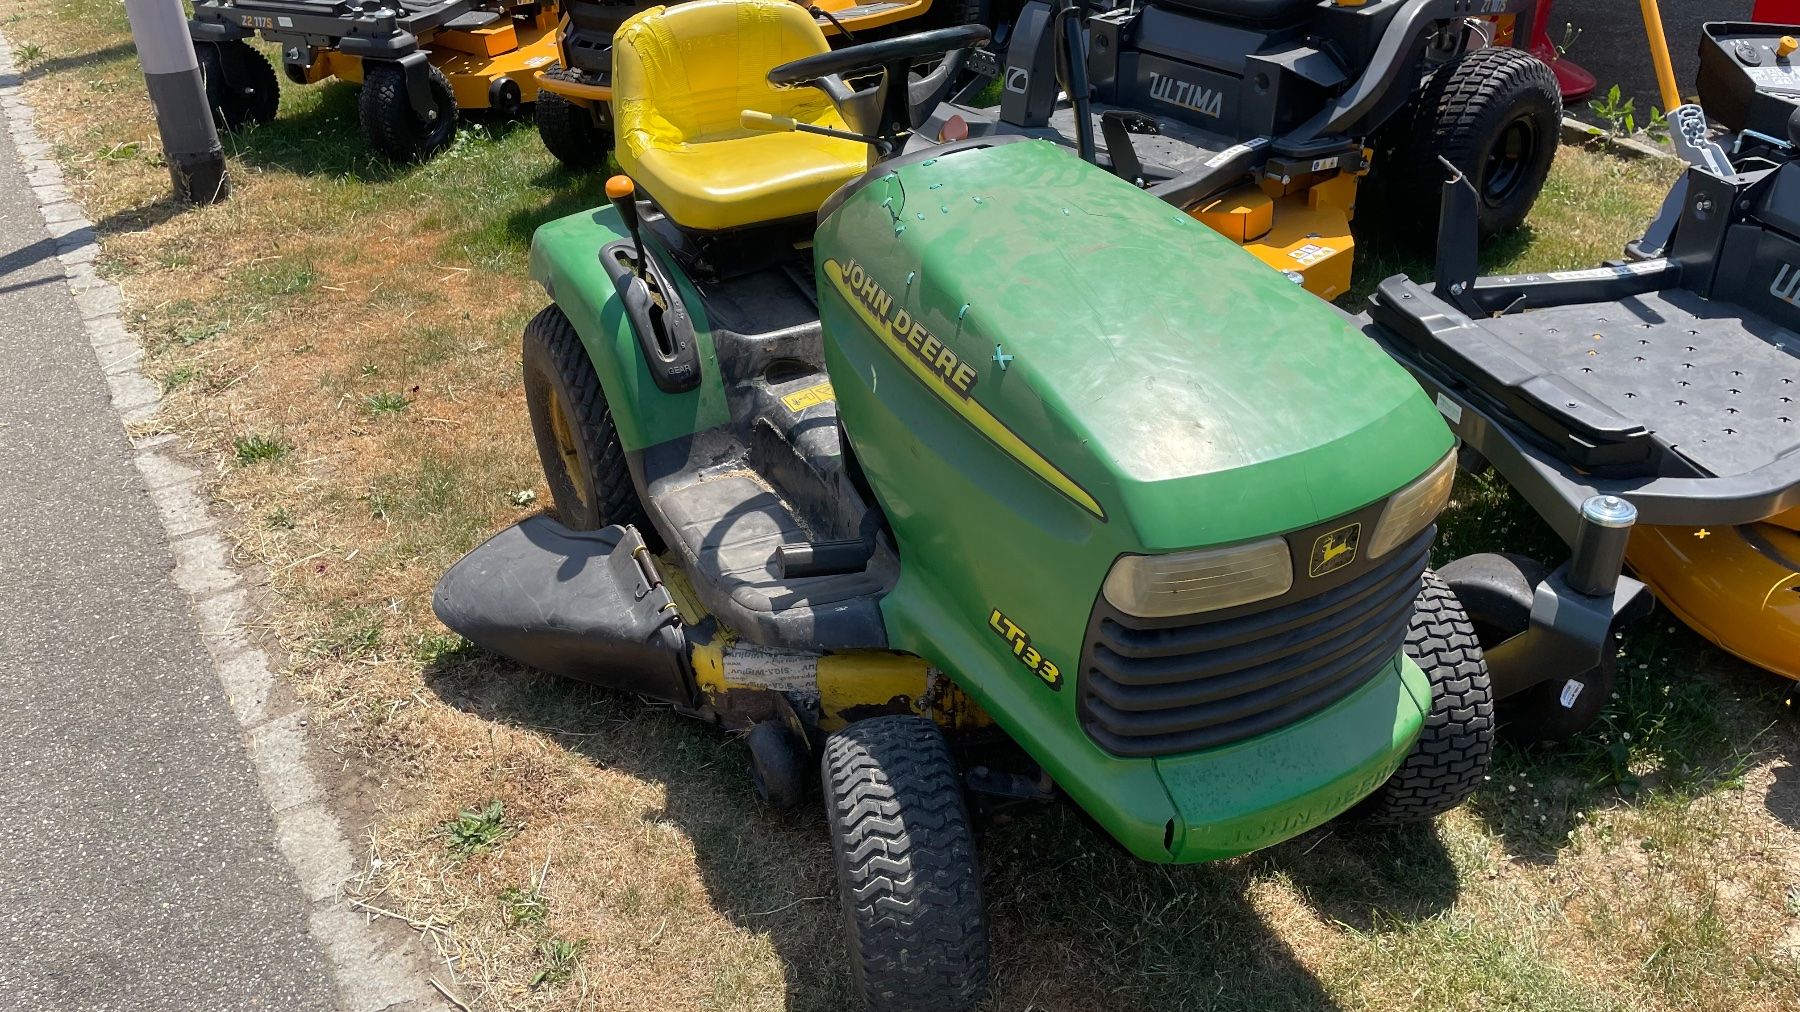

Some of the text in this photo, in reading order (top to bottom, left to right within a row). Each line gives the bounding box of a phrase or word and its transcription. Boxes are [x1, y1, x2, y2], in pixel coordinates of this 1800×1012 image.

[242, 15, 273, 29] Z2 117S
[1149, 71, 1223, 119] ULTIMA
[842, 256, 978, 396] JOHN DEERE
[668, 365, 691, 374] GEAR
[988, 608, 1062, 688] LT133
[1223, 808, 1312, 847] JOHN
